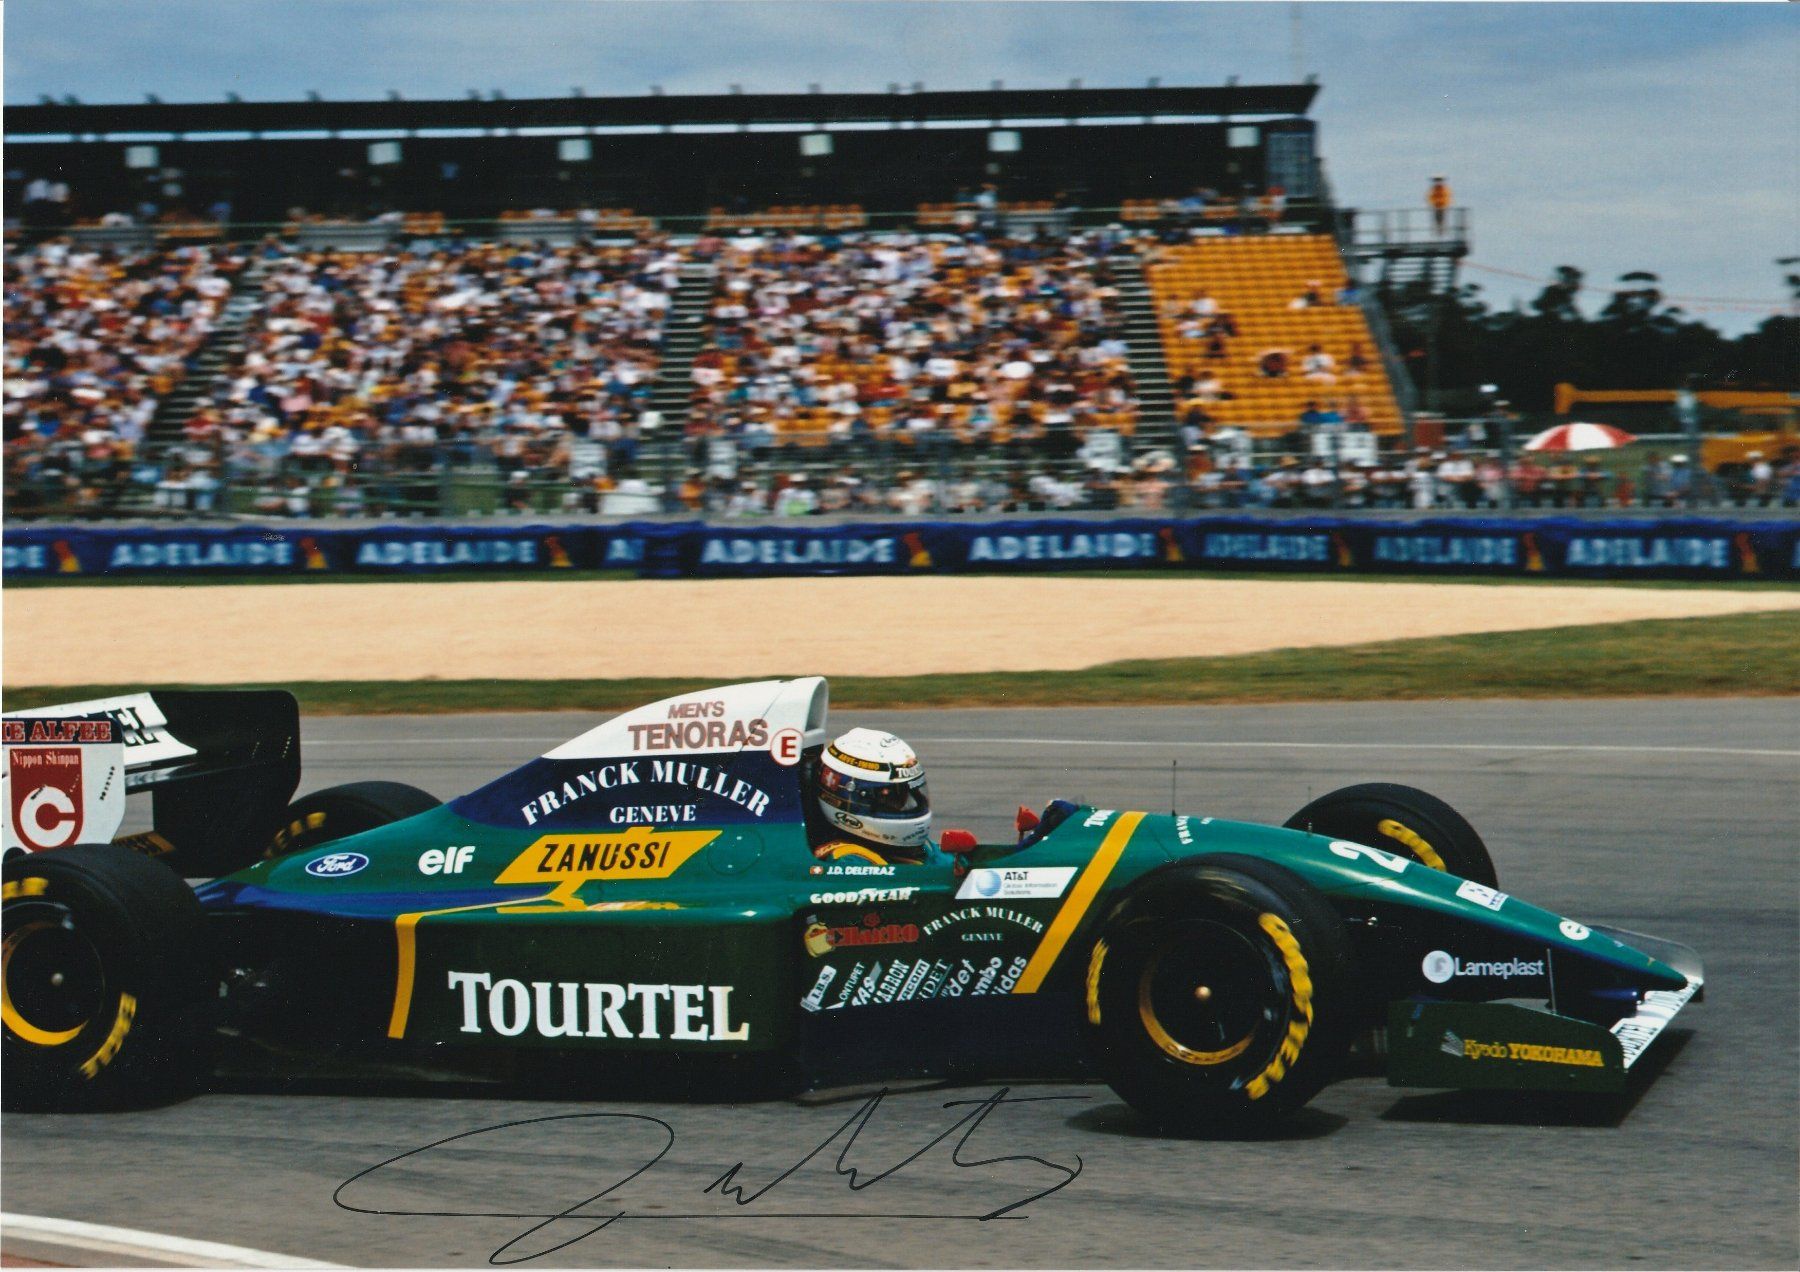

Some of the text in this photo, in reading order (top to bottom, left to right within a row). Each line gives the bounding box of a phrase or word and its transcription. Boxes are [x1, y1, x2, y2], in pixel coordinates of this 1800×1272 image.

[110, 541, 294, 567] ADELAIDE
[357, 540, 537, 565] ADELAIDE
[702, 536, 895, 563] ADELAIDE
[969, 532, 1157, 561] ADELAIDE
[1373, 535, 1518, 566] ADELAIDE
[1565, 537, 1730, 567] ADELAIDE
[667, 701, 725, 719] MEN'S
[29, 720, 112, 742] ALFEE
[627, 718, 769, 751] TENORAS
[521, 760, 771, 826] FRANCK MULLER
[609, 804, 697, 824] GENEVE
[315, 853, 359, 874] Ford
[418, 846, 476, 875] elf
[537, 841, 672, 873] ZANUSSI
[1004, 871, 1029, 881] AT&T
[810, 887, 920, 905] GOODYEAR
[923, 907, 1043, 935] FRANCK MULLER
[1455, 957, 1545, 980] Lameplast
[448, 970, 750, 1042] TOURTEL
[1508, 1042, 1605, 1067] YOKOHAMA
